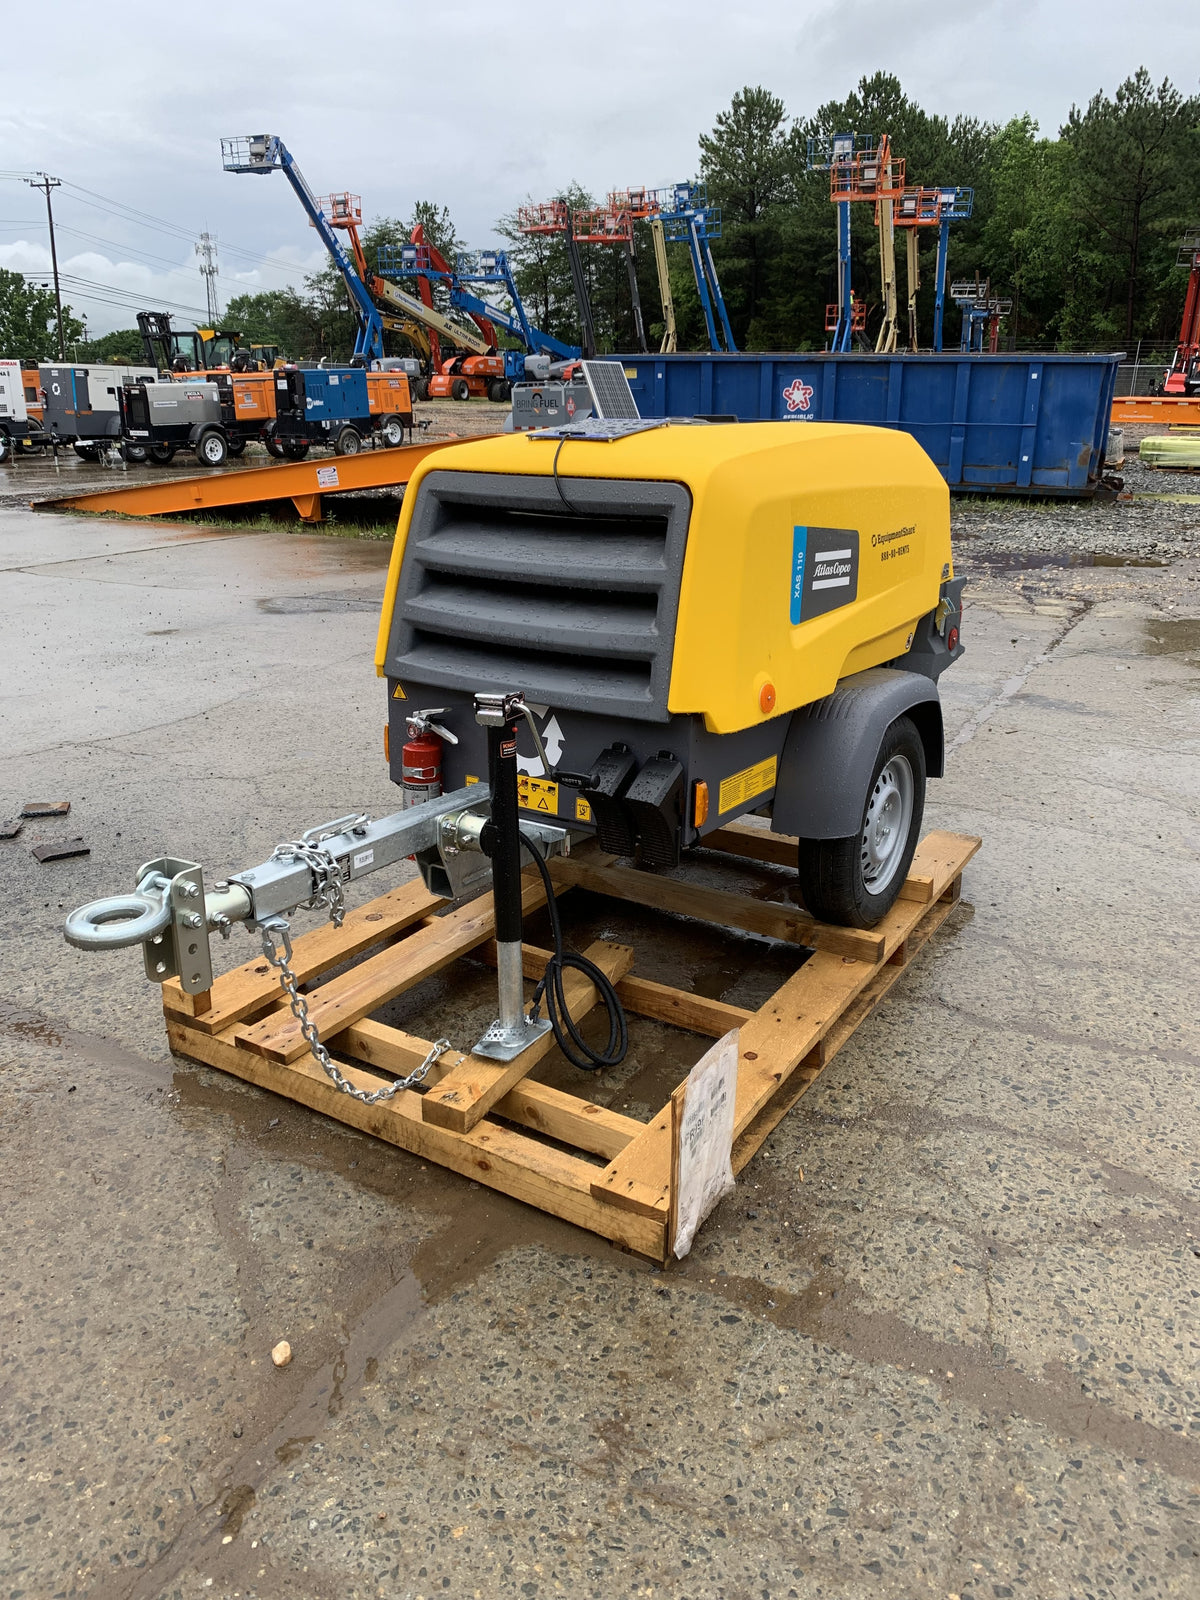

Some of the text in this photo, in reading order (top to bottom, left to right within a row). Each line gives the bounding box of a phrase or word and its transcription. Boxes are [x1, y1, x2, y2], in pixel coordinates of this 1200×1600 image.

[454, 328, 468, 340] ULTRA
[468, 338, 481, 348] BOOM
[516, 399, 559, 409] BRING FUEL
[877, 526, 916, 545] EquipmentShare
[813, 562, 852, 577] Atlas Copco
[794, 575, 802, 599] XAS
